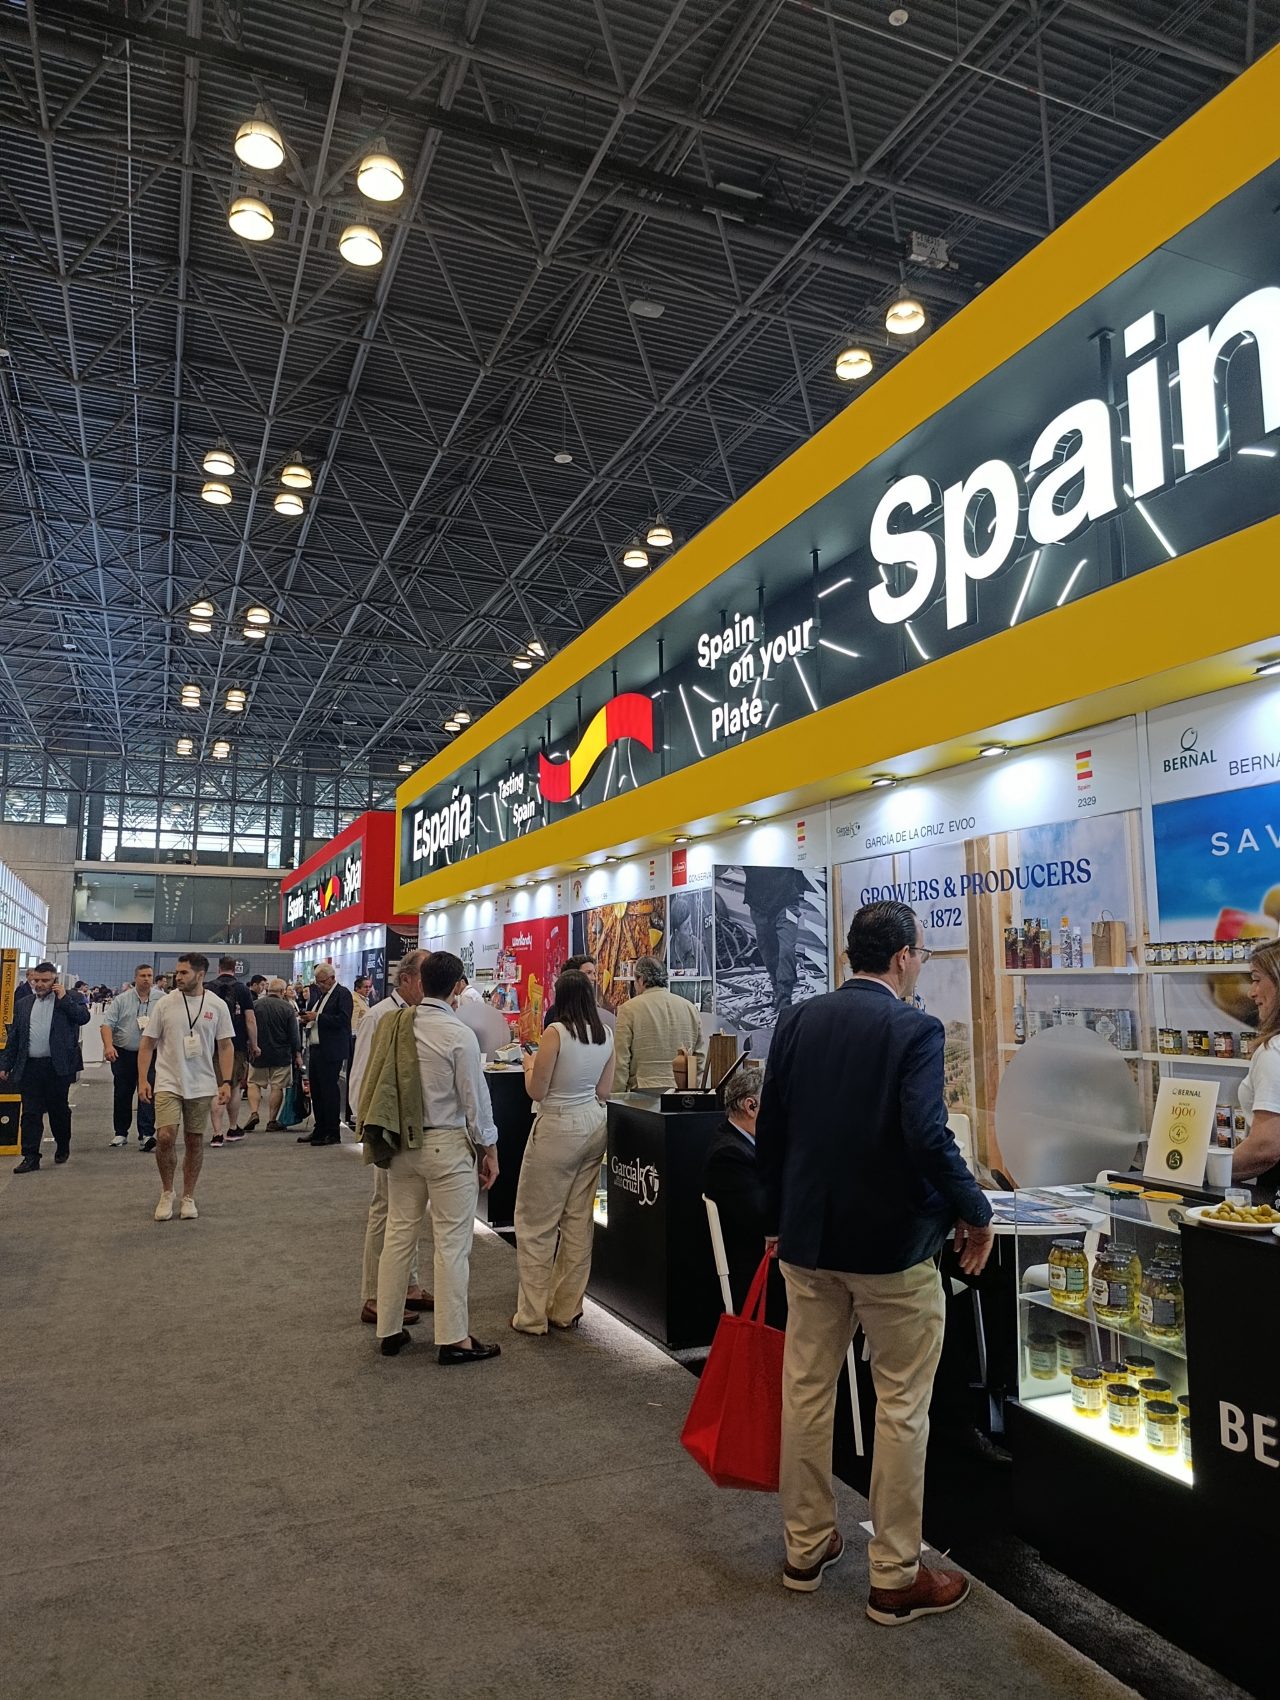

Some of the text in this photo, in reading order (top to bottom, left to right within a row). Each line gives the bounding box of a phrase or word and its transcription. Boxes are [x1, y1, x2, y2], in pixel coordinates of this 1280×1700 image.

[868, 287, 1280, 630] Spain
[698, 612, 755, 670] Spain
[729, 617, 814, 688] on your
[711, 697, 763, 742] Plate
[1163, 749, 1218, 772] BERNAL
[498, 771, 524, 800] Tasting
[512, 796, 536, 828] Spain
[1077, 796, 1097, 808] 2329
[412, 784, 471, 866] España
[865, 816, 976, 849] GARCÍA DE LA CRUZ EVOO
[860, 858, 1092, 906] GROWERS & PRODUCERS
[930, 907, 962, 929] 1872
[1177, 1089, 1202, 1098] BERNAL
[1171, 1105, 1197, 1121] 1900
[611, 1155, 638, 1182] García
[622, 1178, 638, 1194] cruz
[1219, 1400, 1280, 1469] BE
